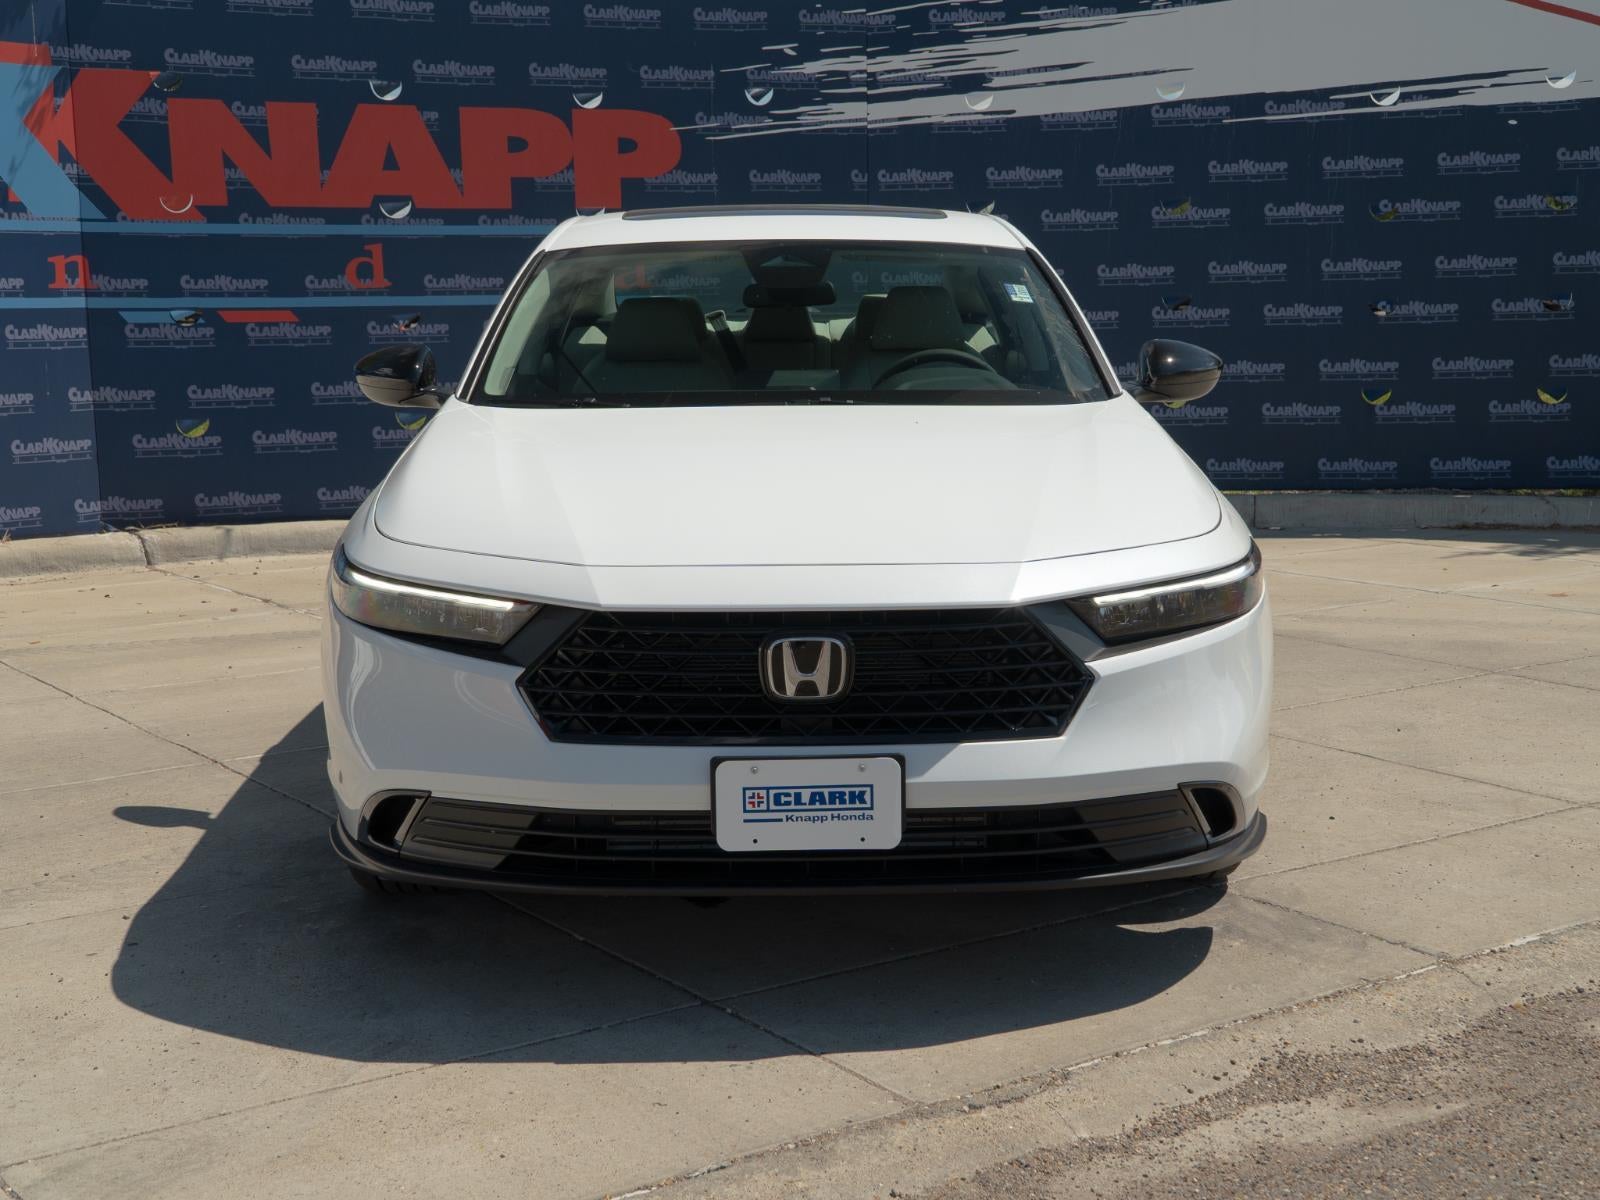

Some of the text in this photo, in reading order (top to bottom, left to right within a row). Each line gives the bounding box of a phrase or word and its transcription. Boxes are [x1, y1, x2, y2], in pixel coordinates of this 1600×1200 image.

[773, 790, 868, 807] CLARK
[785, 813, 874, 824] Knapp Honda
